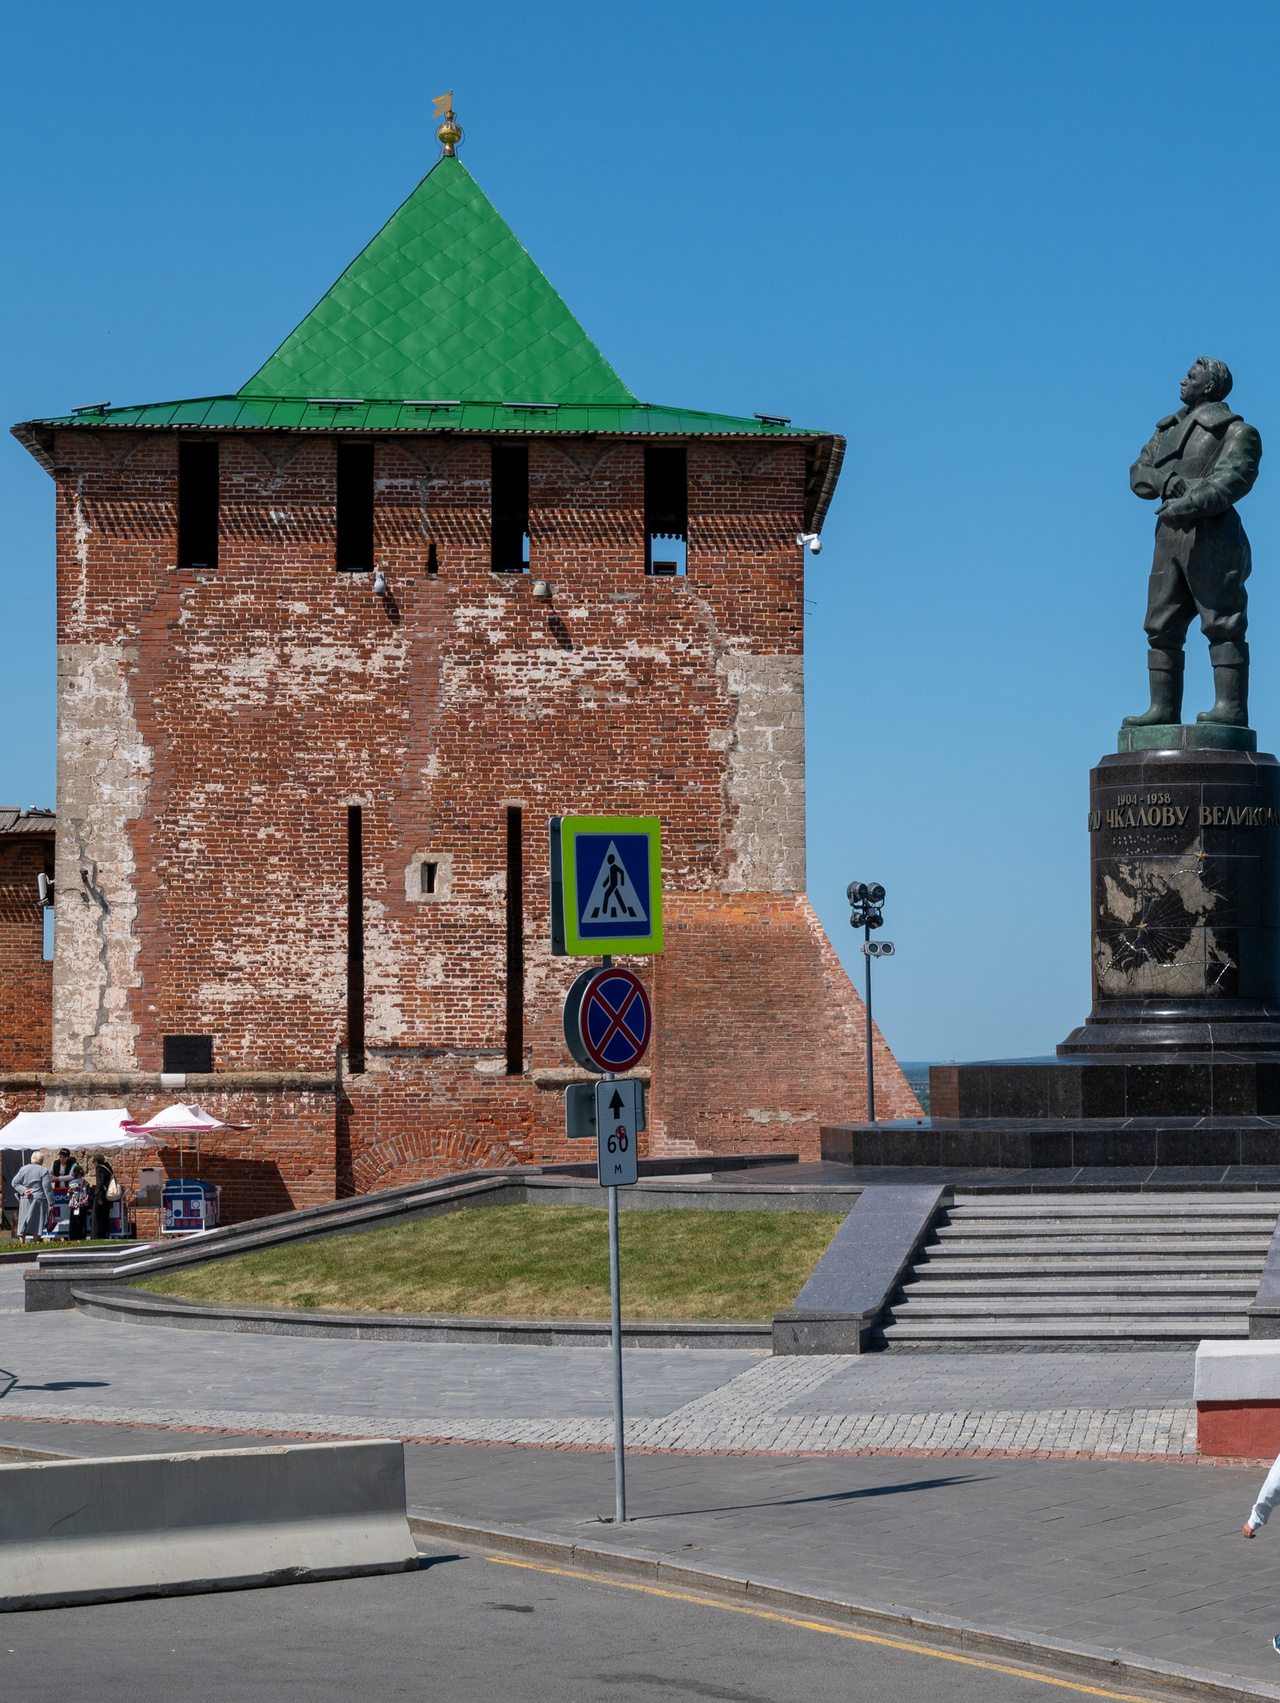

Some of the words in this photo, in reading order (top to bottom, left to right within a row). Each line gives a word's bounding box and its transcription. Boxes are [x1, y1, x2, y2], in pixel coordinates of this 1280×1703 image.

[1117, 794, 1137, 806] 1904
[1147, 793, 1171, 805] 1938
[1106, 806, 1189, 829] ЧКАЛОВУ
[607, 1134, 629, 1154] 60
